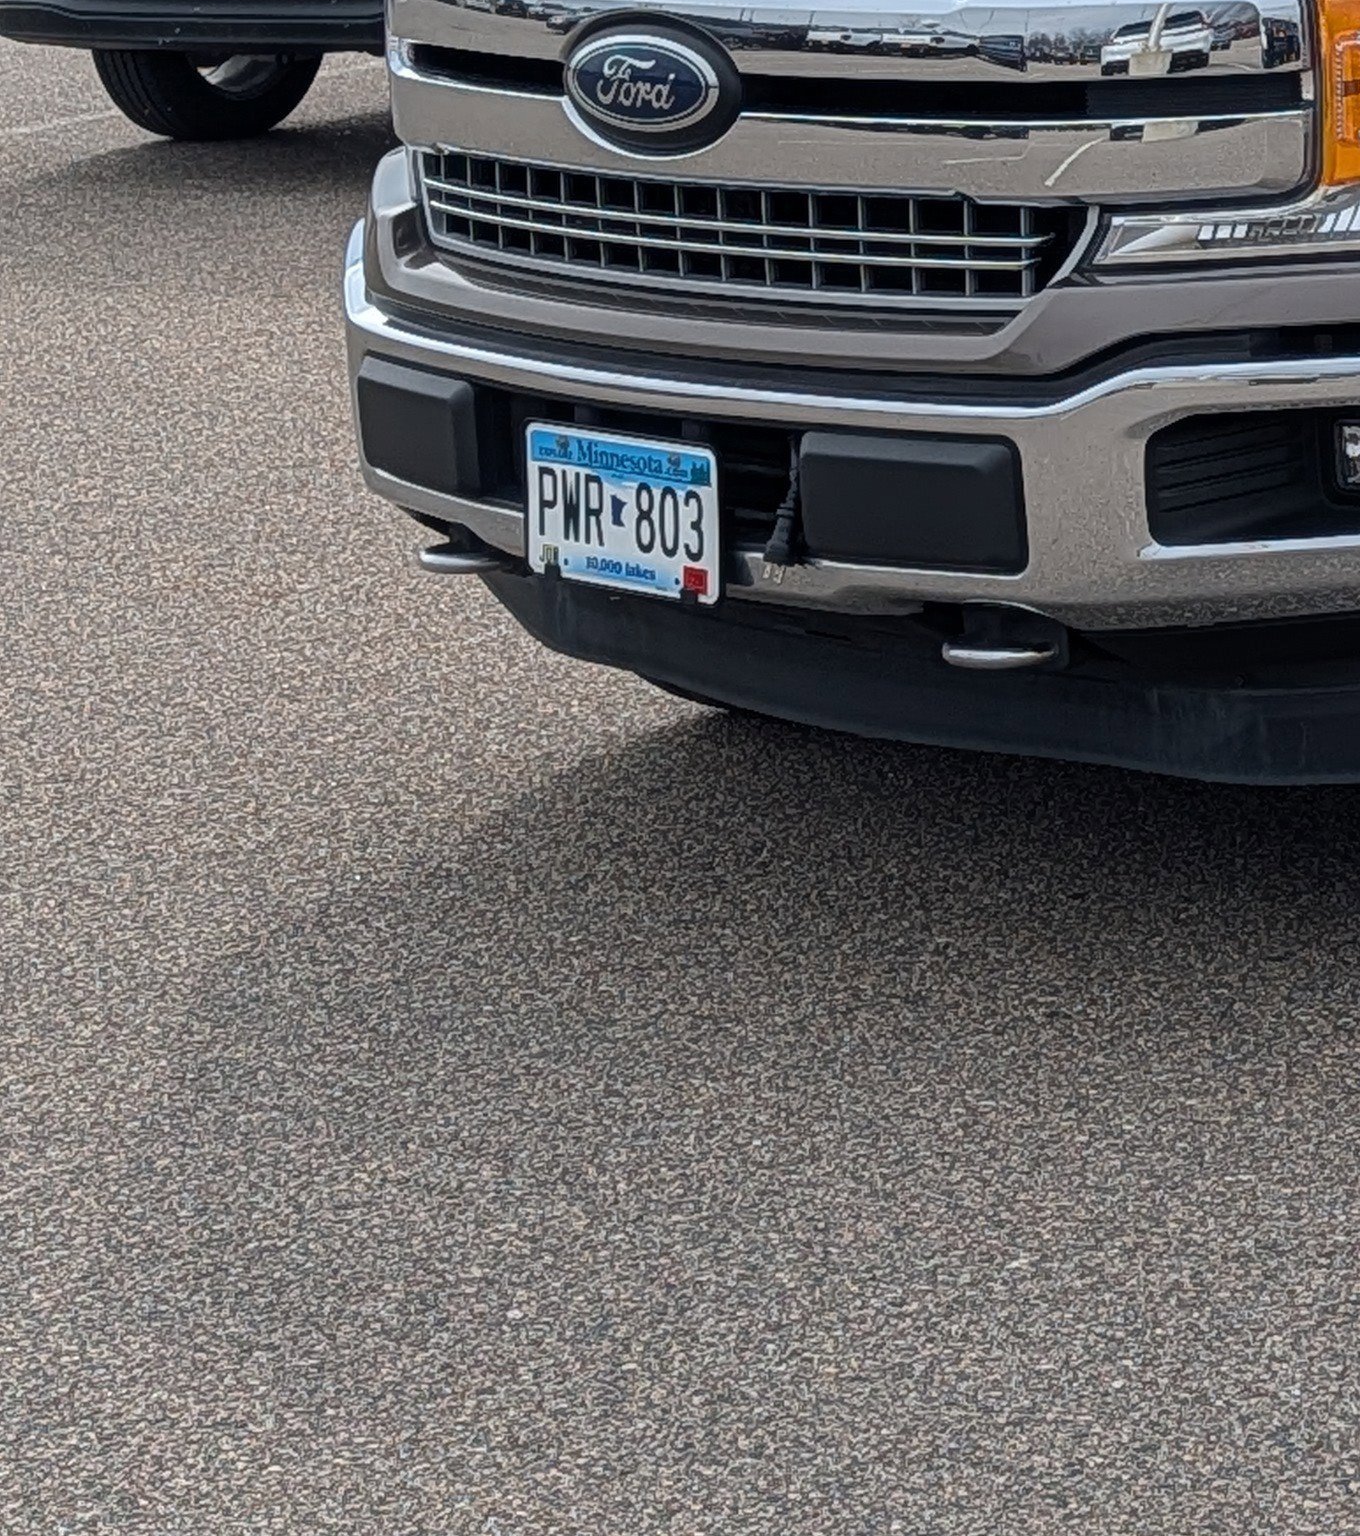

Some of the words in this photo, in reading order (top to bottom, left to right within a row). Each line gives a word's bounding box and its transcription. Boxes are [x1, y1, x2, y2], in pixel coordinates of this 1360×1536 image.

[596, 54, 676, 110] Ford
[576, 440, 664, 475] Minnesota
[537, 465, 605, 547] PWR
[635, 482, 705, 562] 803
[625, 562, 656, 580] lakes
